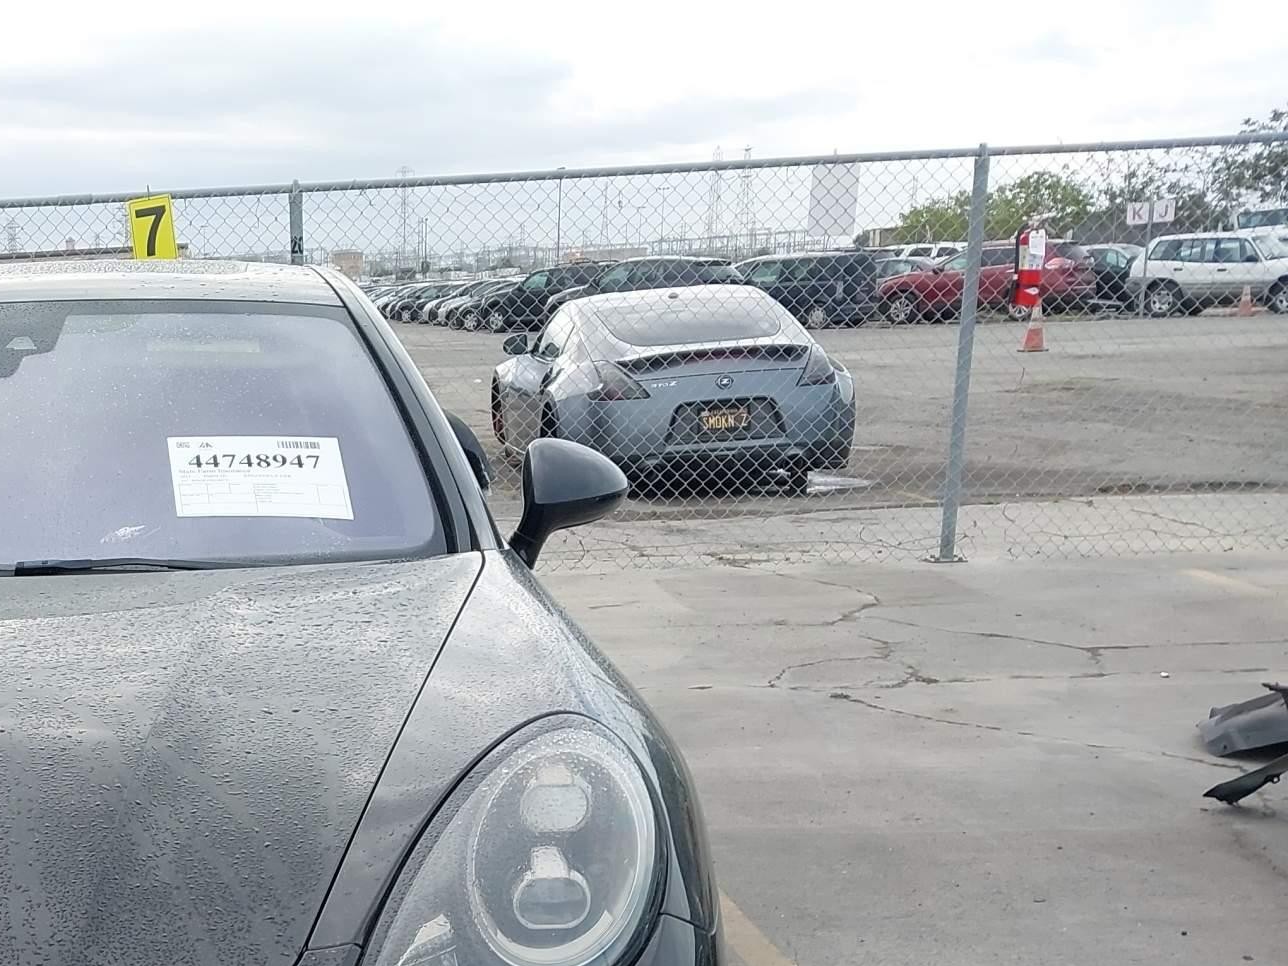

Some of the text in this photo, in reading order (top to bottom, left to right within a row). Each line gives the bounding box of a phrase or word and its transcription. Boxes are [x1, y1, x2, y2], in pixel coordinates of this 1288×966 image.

[1132, 206, 1143, 221] K
[1158, 204, 1169, 218] J
[134, 204, 166, 257] 7
[702, 413, 748, 430] SMOKN Z
[188, 453, 321, 469] 44748947
